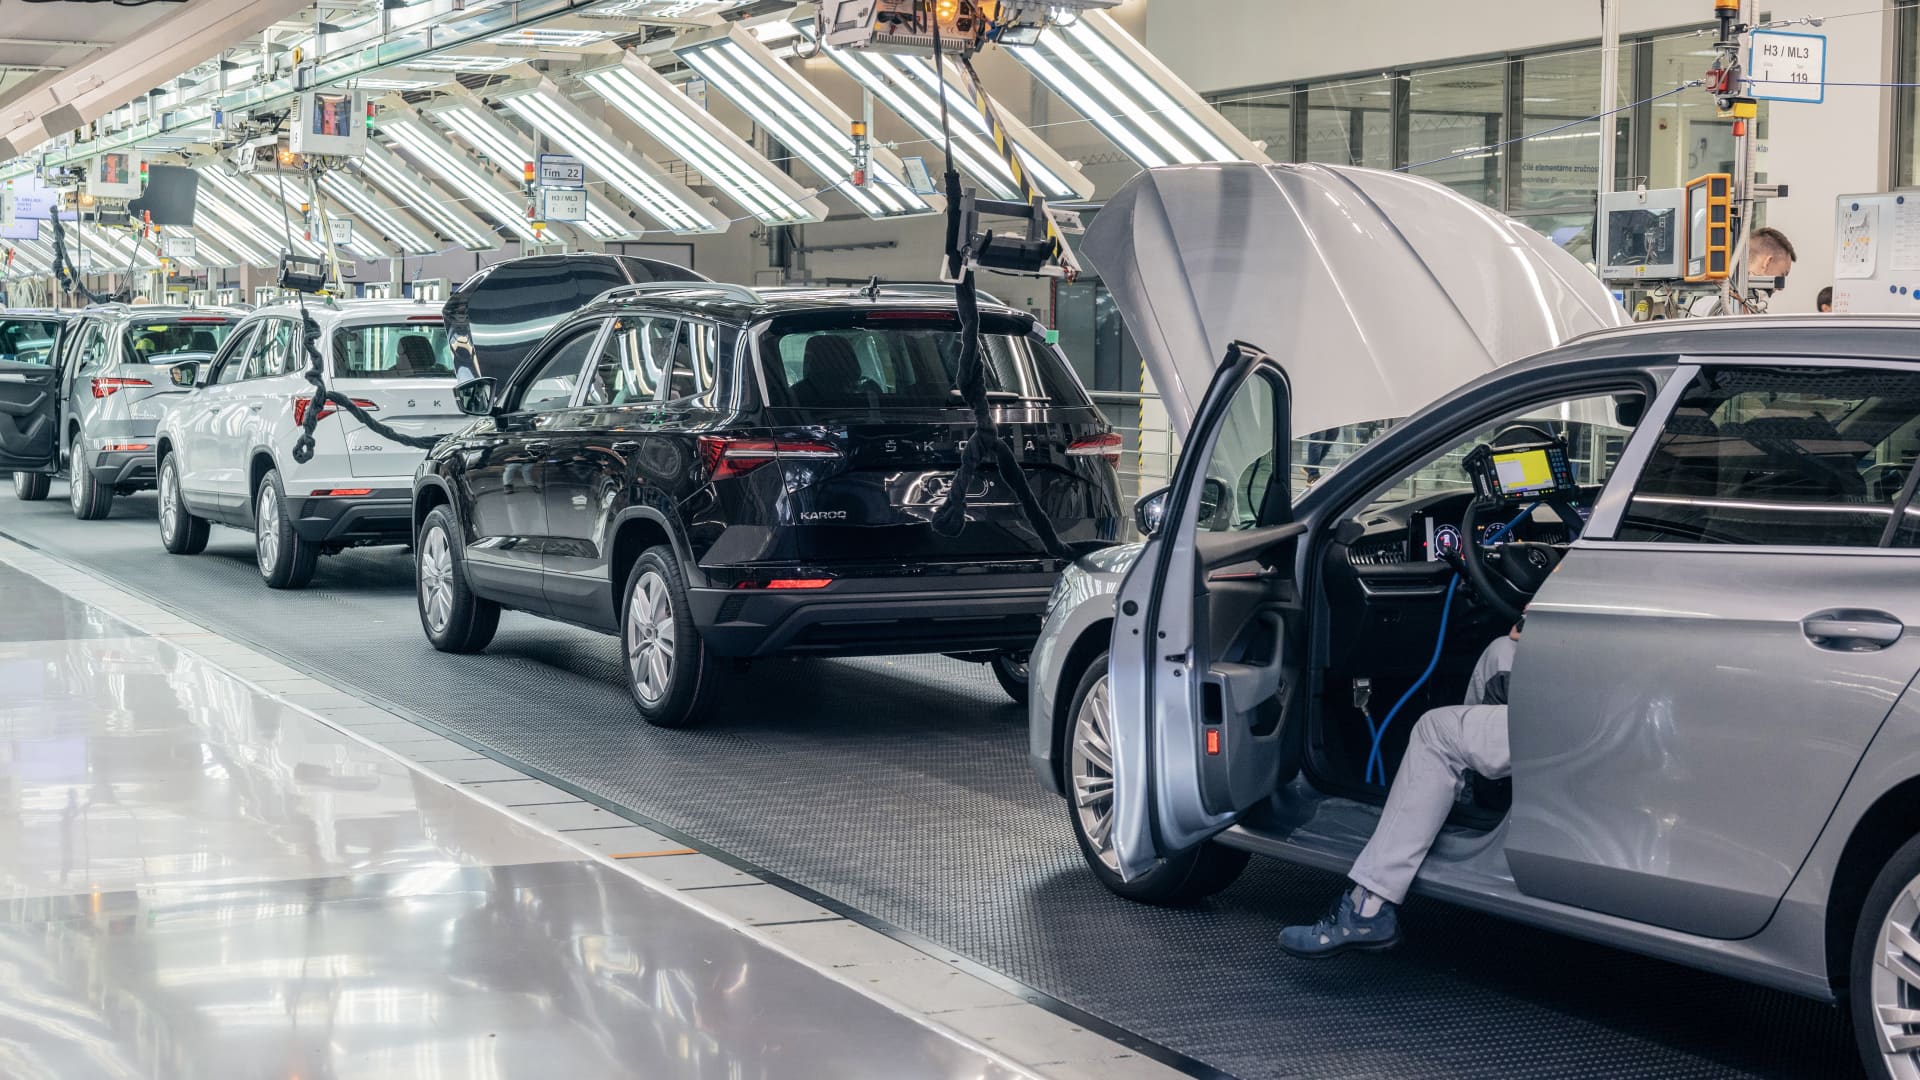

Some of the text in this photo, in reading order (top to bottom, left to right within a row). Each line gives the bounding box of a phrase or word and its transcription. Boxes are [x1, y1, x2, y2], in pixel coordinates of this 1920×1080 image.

[1763, 44, 1778, 57] H3
[1787, 46, 1809, 59] ML3
[1790, 72, 1808, 83] 119
[567, 168, 579, 178] 22
[800, 510, 848, 520] KAROQ
